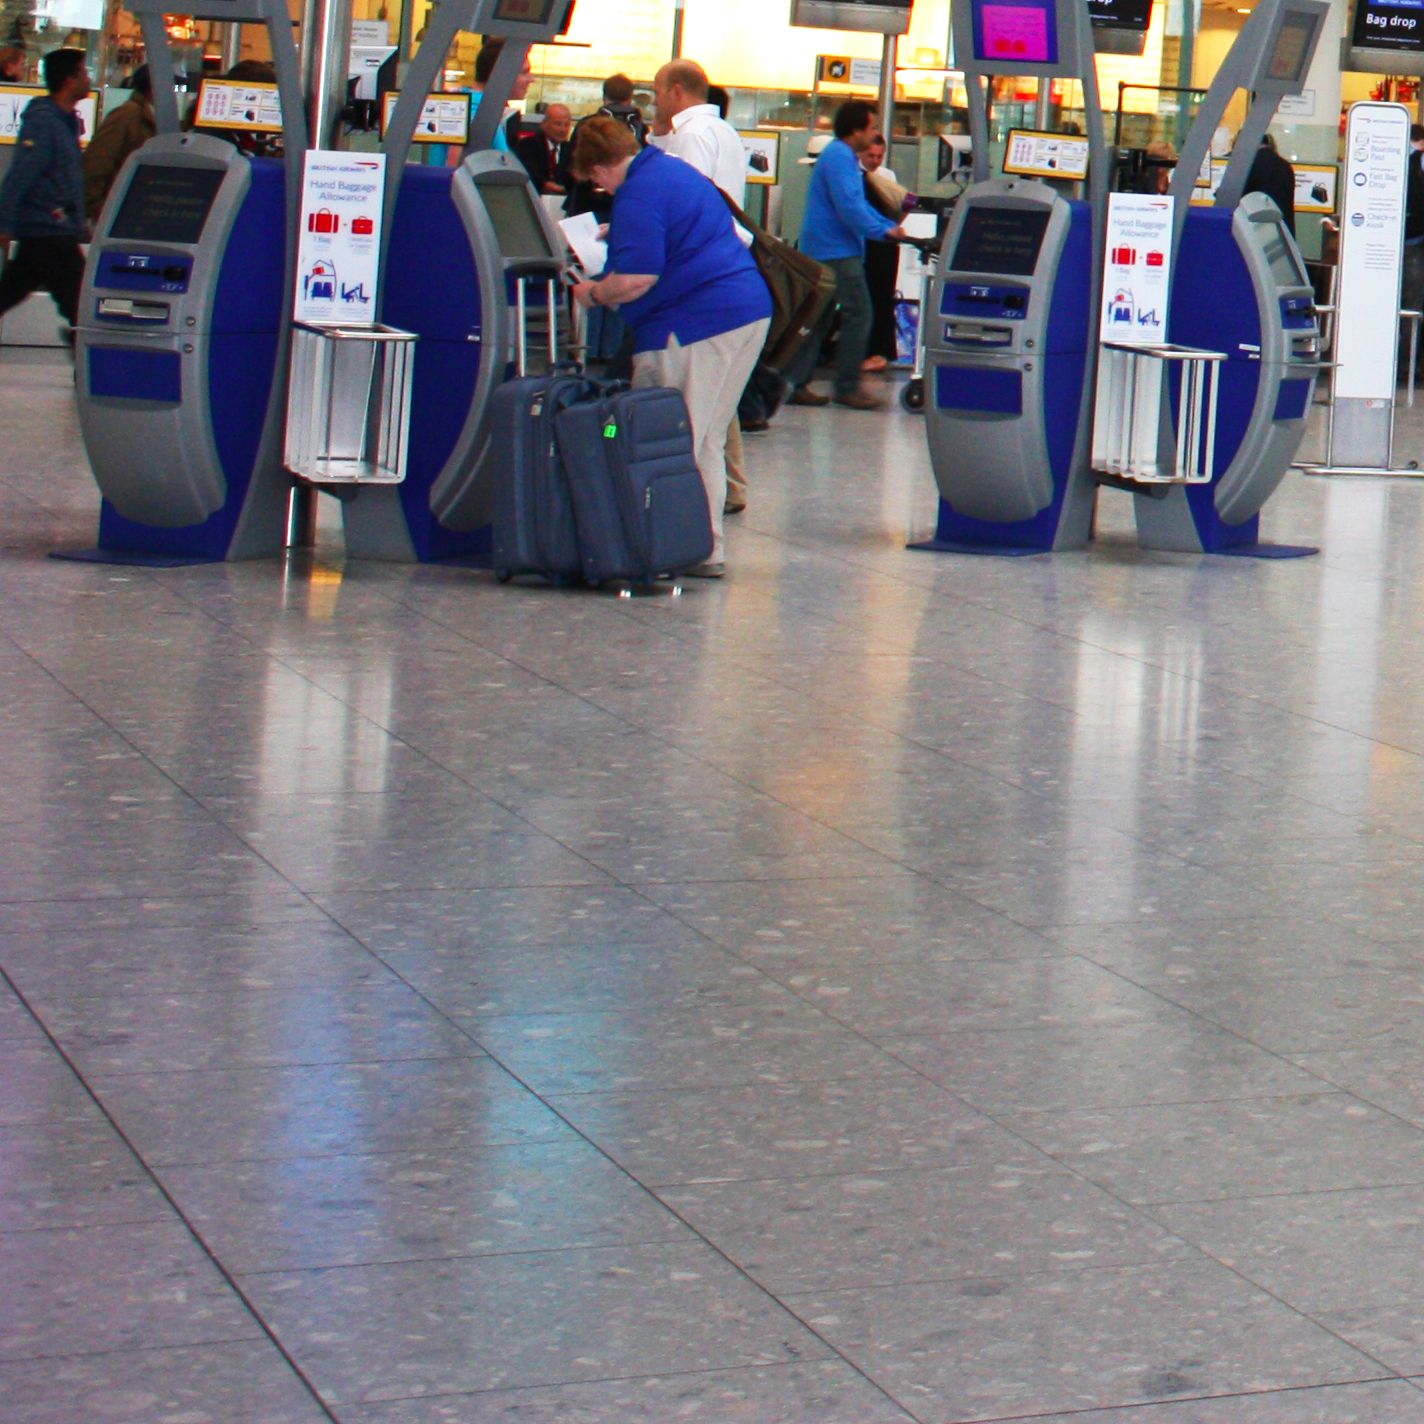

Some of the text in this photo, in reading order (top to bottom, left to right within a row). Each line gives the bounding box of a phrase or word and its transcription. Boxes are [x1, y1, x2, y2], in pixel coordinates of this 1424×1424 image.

[1366, 12, 1416, 30] Bag drop
[310, 180, 377, 193] Hand Baggage
[318, 191, 368, 203] Allowance
